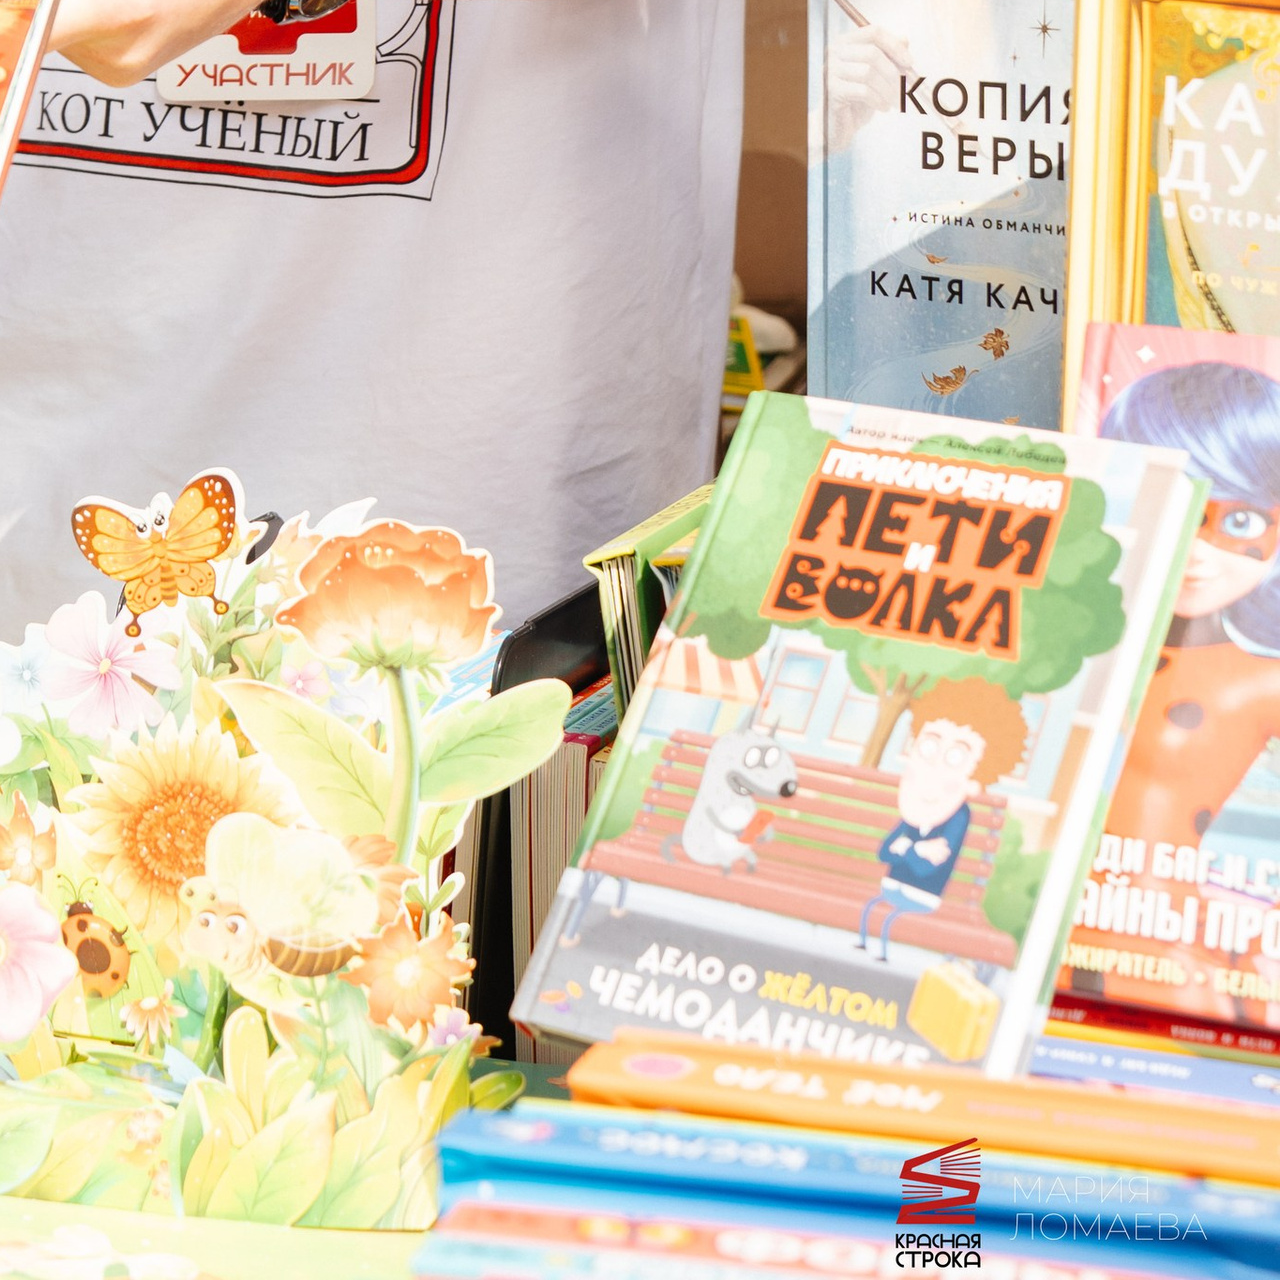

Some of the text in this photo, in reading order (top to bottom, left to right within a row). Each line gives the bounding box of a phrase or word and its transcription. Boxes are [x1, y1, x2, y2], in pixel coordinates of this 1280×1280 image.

[176, 62, 355, 88] УЧАСТНИК
[36, 90, 374, 162] КОТ УЧЁНЫЙ
[920, 131, 1066, 181] ВЕРЫ
[908, 212, 1066, 236] ИСТИНА ОБМАНЧИ
[870, 271, 1058, 315] КАТЯ КАЧ
[821, 447, 1064, 511] ПРИКЛЮЧЕНИЯ
[798, 481, 1054, 576] ПЕТИ
[902, 542, 936, 573] И
[776, 553, 1012, 650] ВОЛКА
[634, 942, 899, 1031] ДЕЛО О ЖЁЛТОМ
